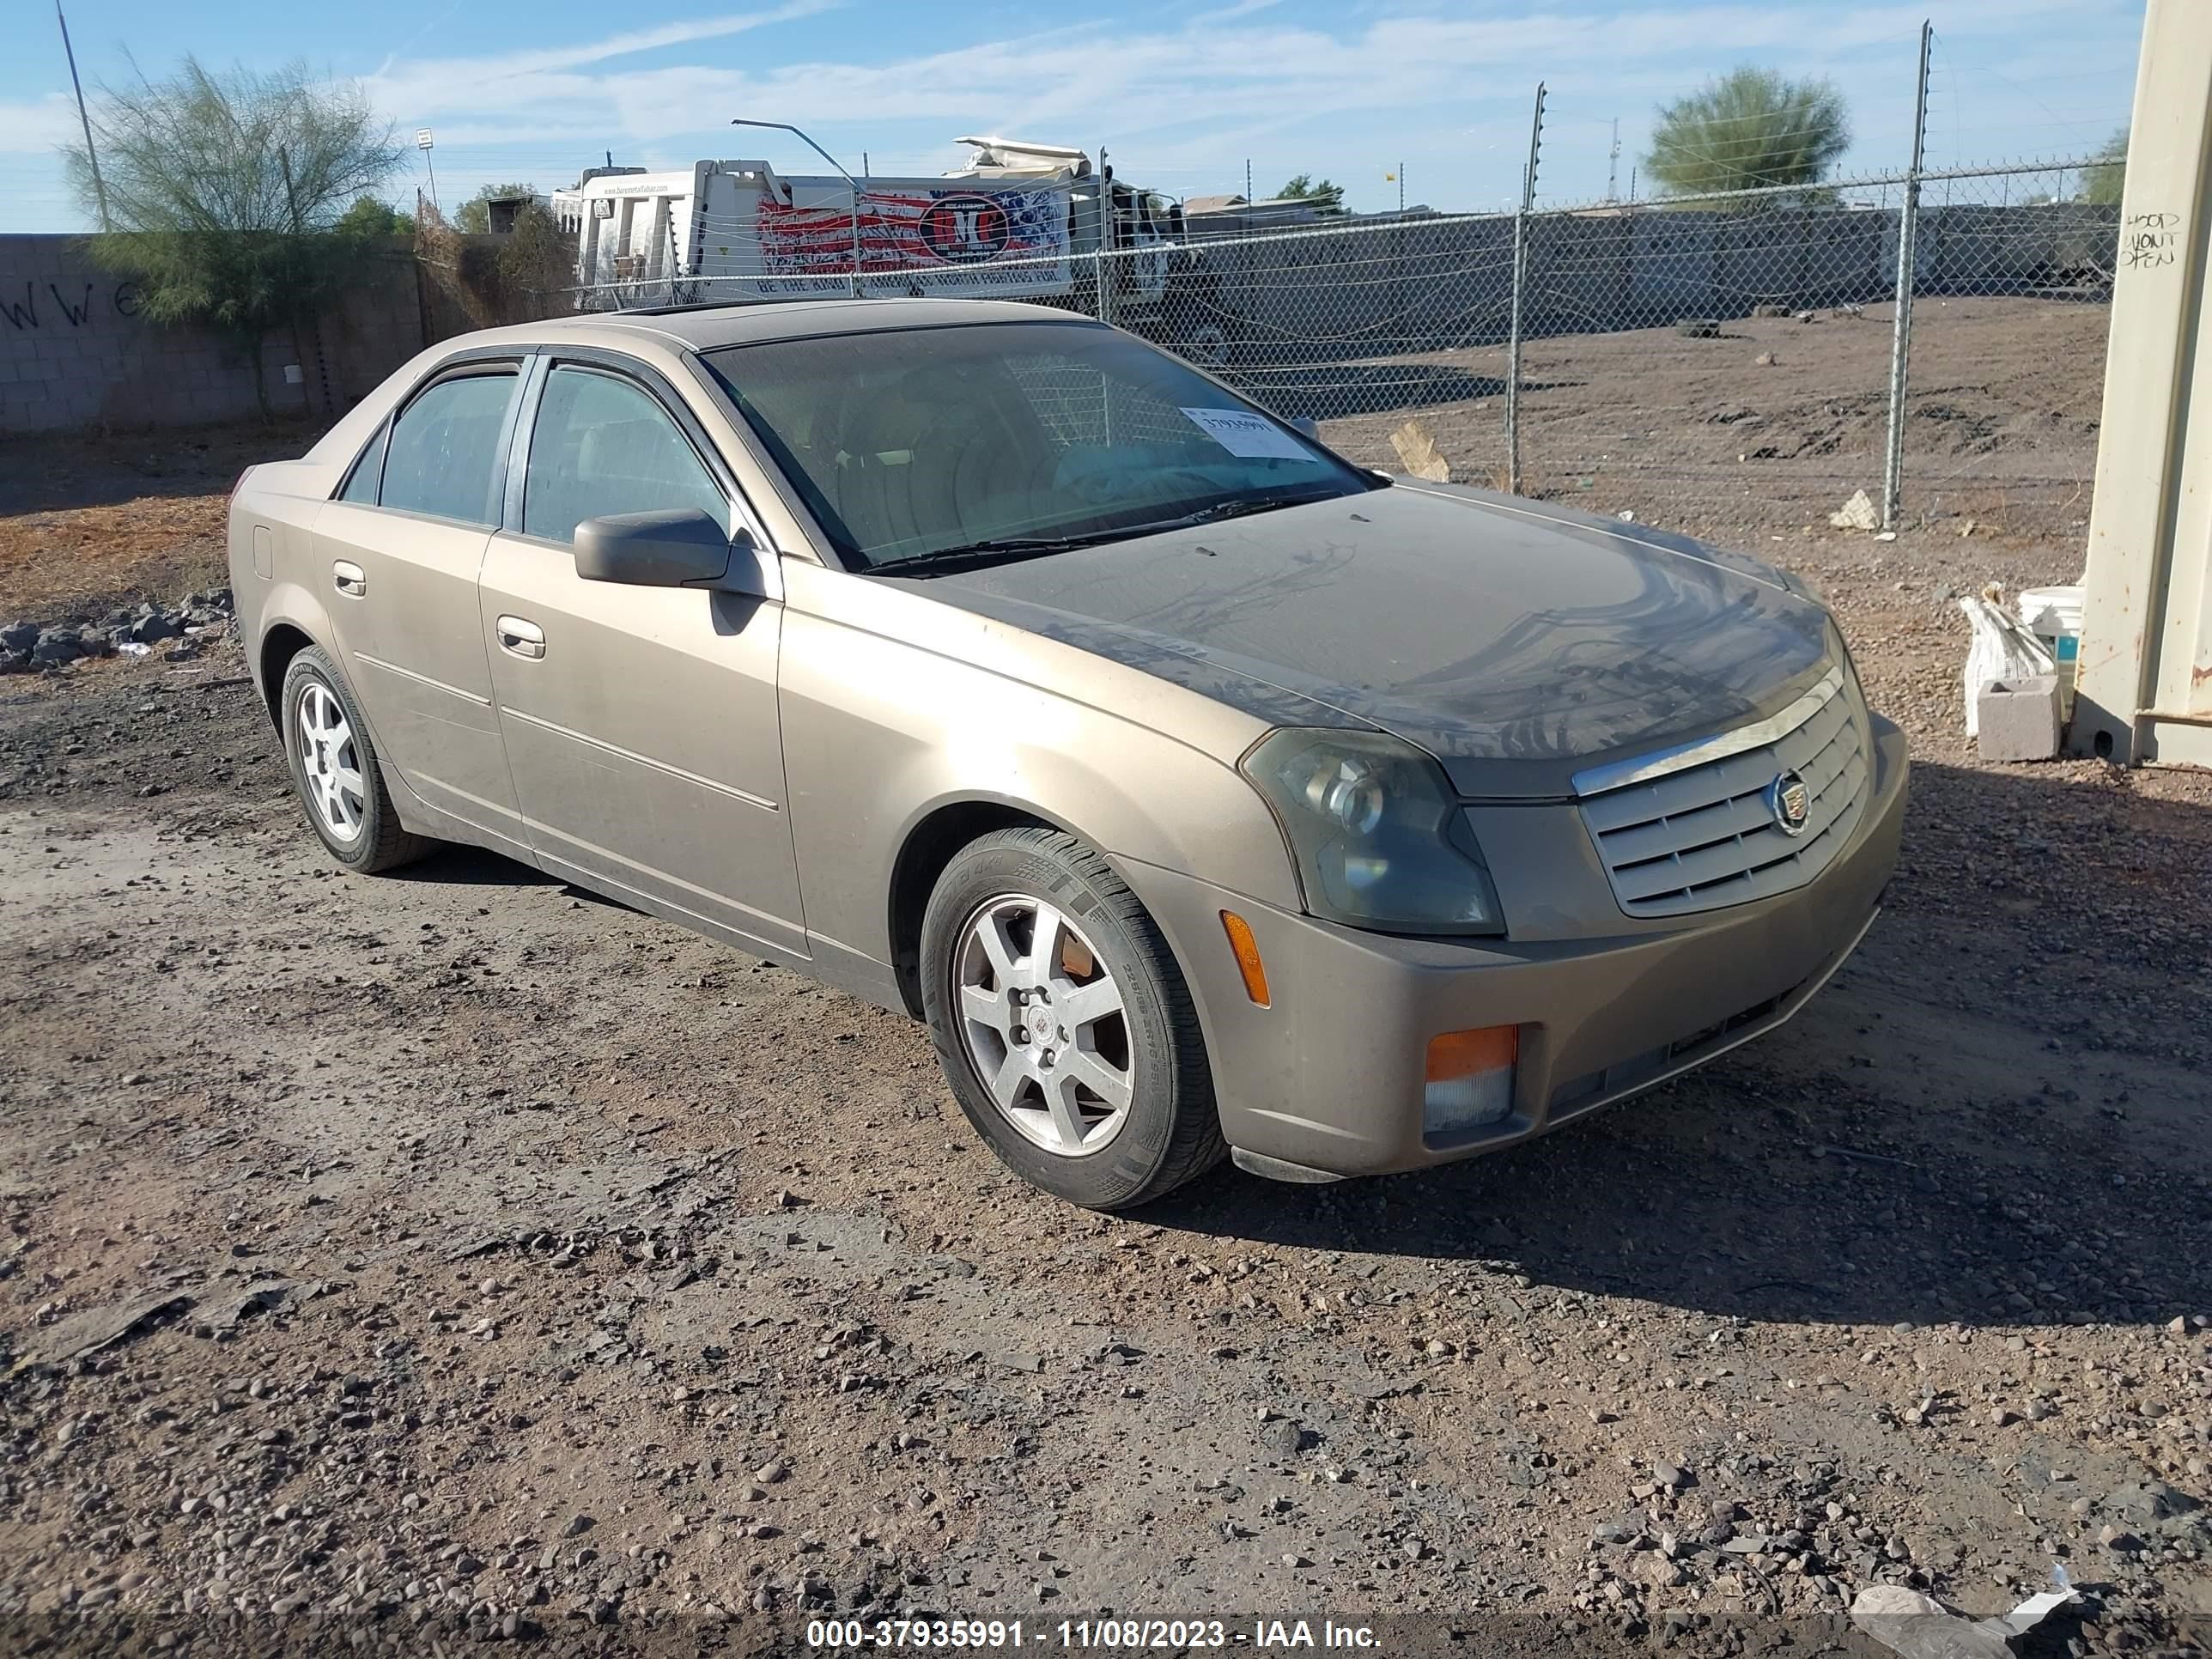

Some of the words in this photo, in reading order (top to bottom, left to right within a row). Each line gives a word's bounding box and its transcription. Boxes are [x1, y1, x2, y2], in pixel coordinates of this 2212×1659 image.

[757, 279, 778, 293] BE
[782, 279, 809, 292] THE
[1203, 418, 1273, 432] 37935991
